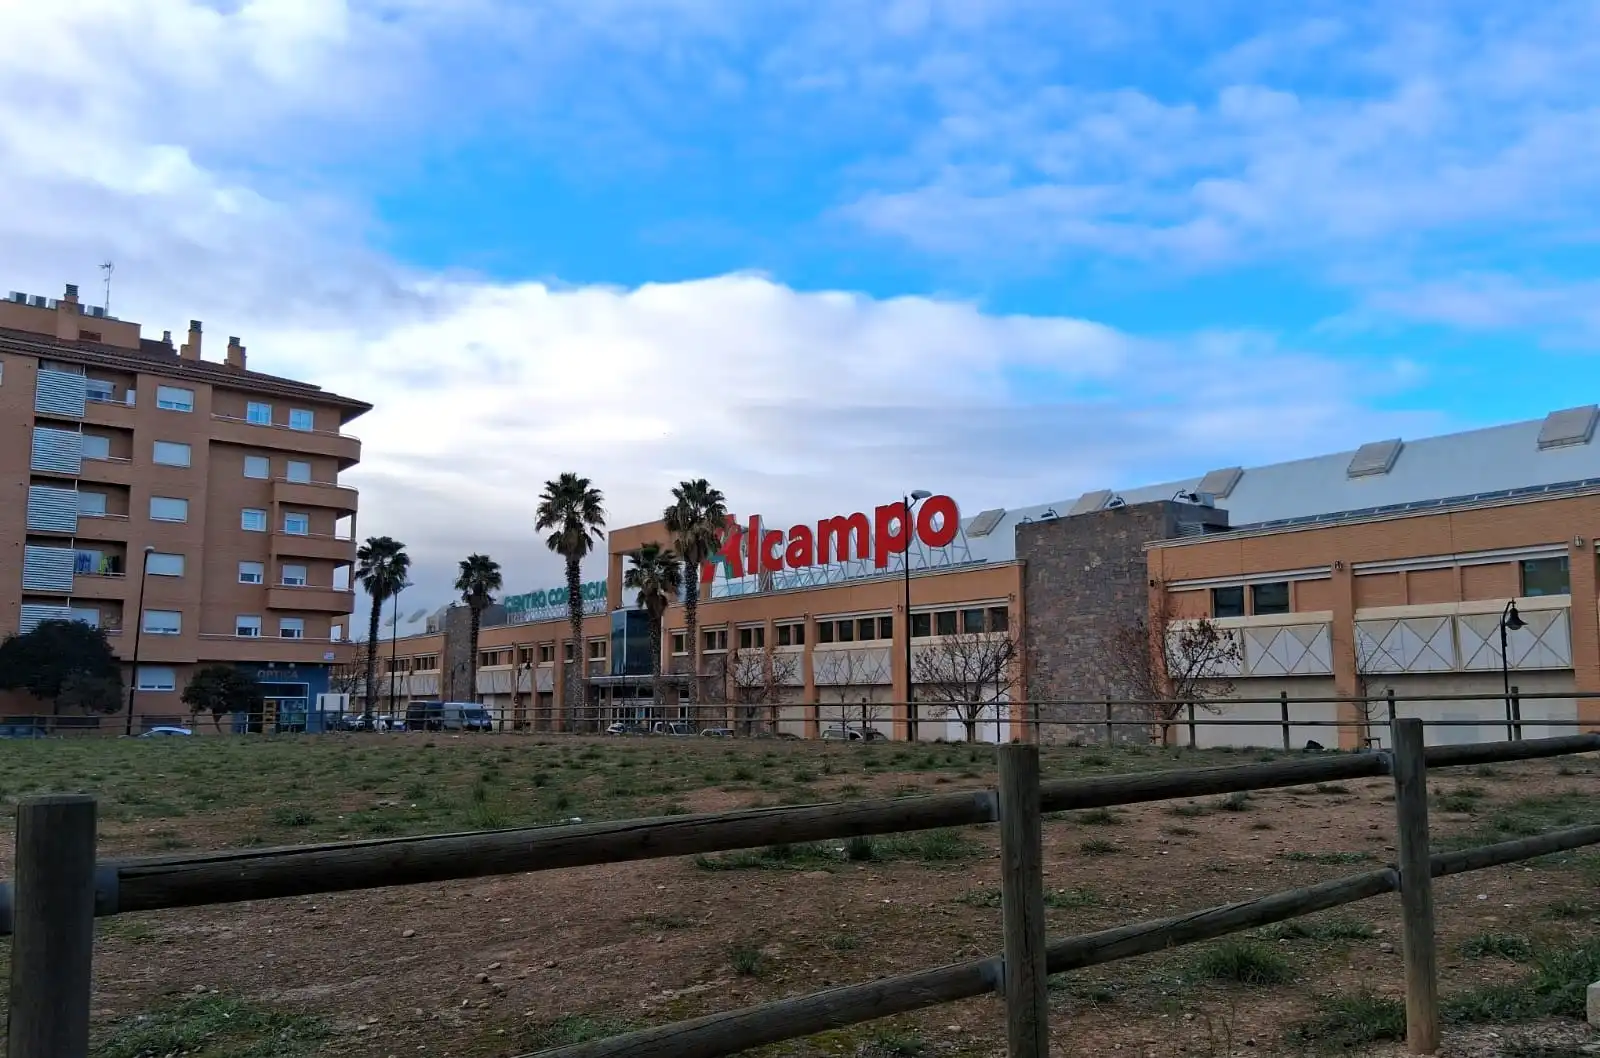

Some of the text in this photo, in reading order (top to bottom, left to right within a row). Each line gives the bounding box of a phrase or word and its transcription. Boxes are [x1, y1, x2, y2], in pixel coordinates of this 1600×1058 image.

[700, 495, 959, 583] Alcampo
[505, 582, 608, 613] CENTRO CORCIA
